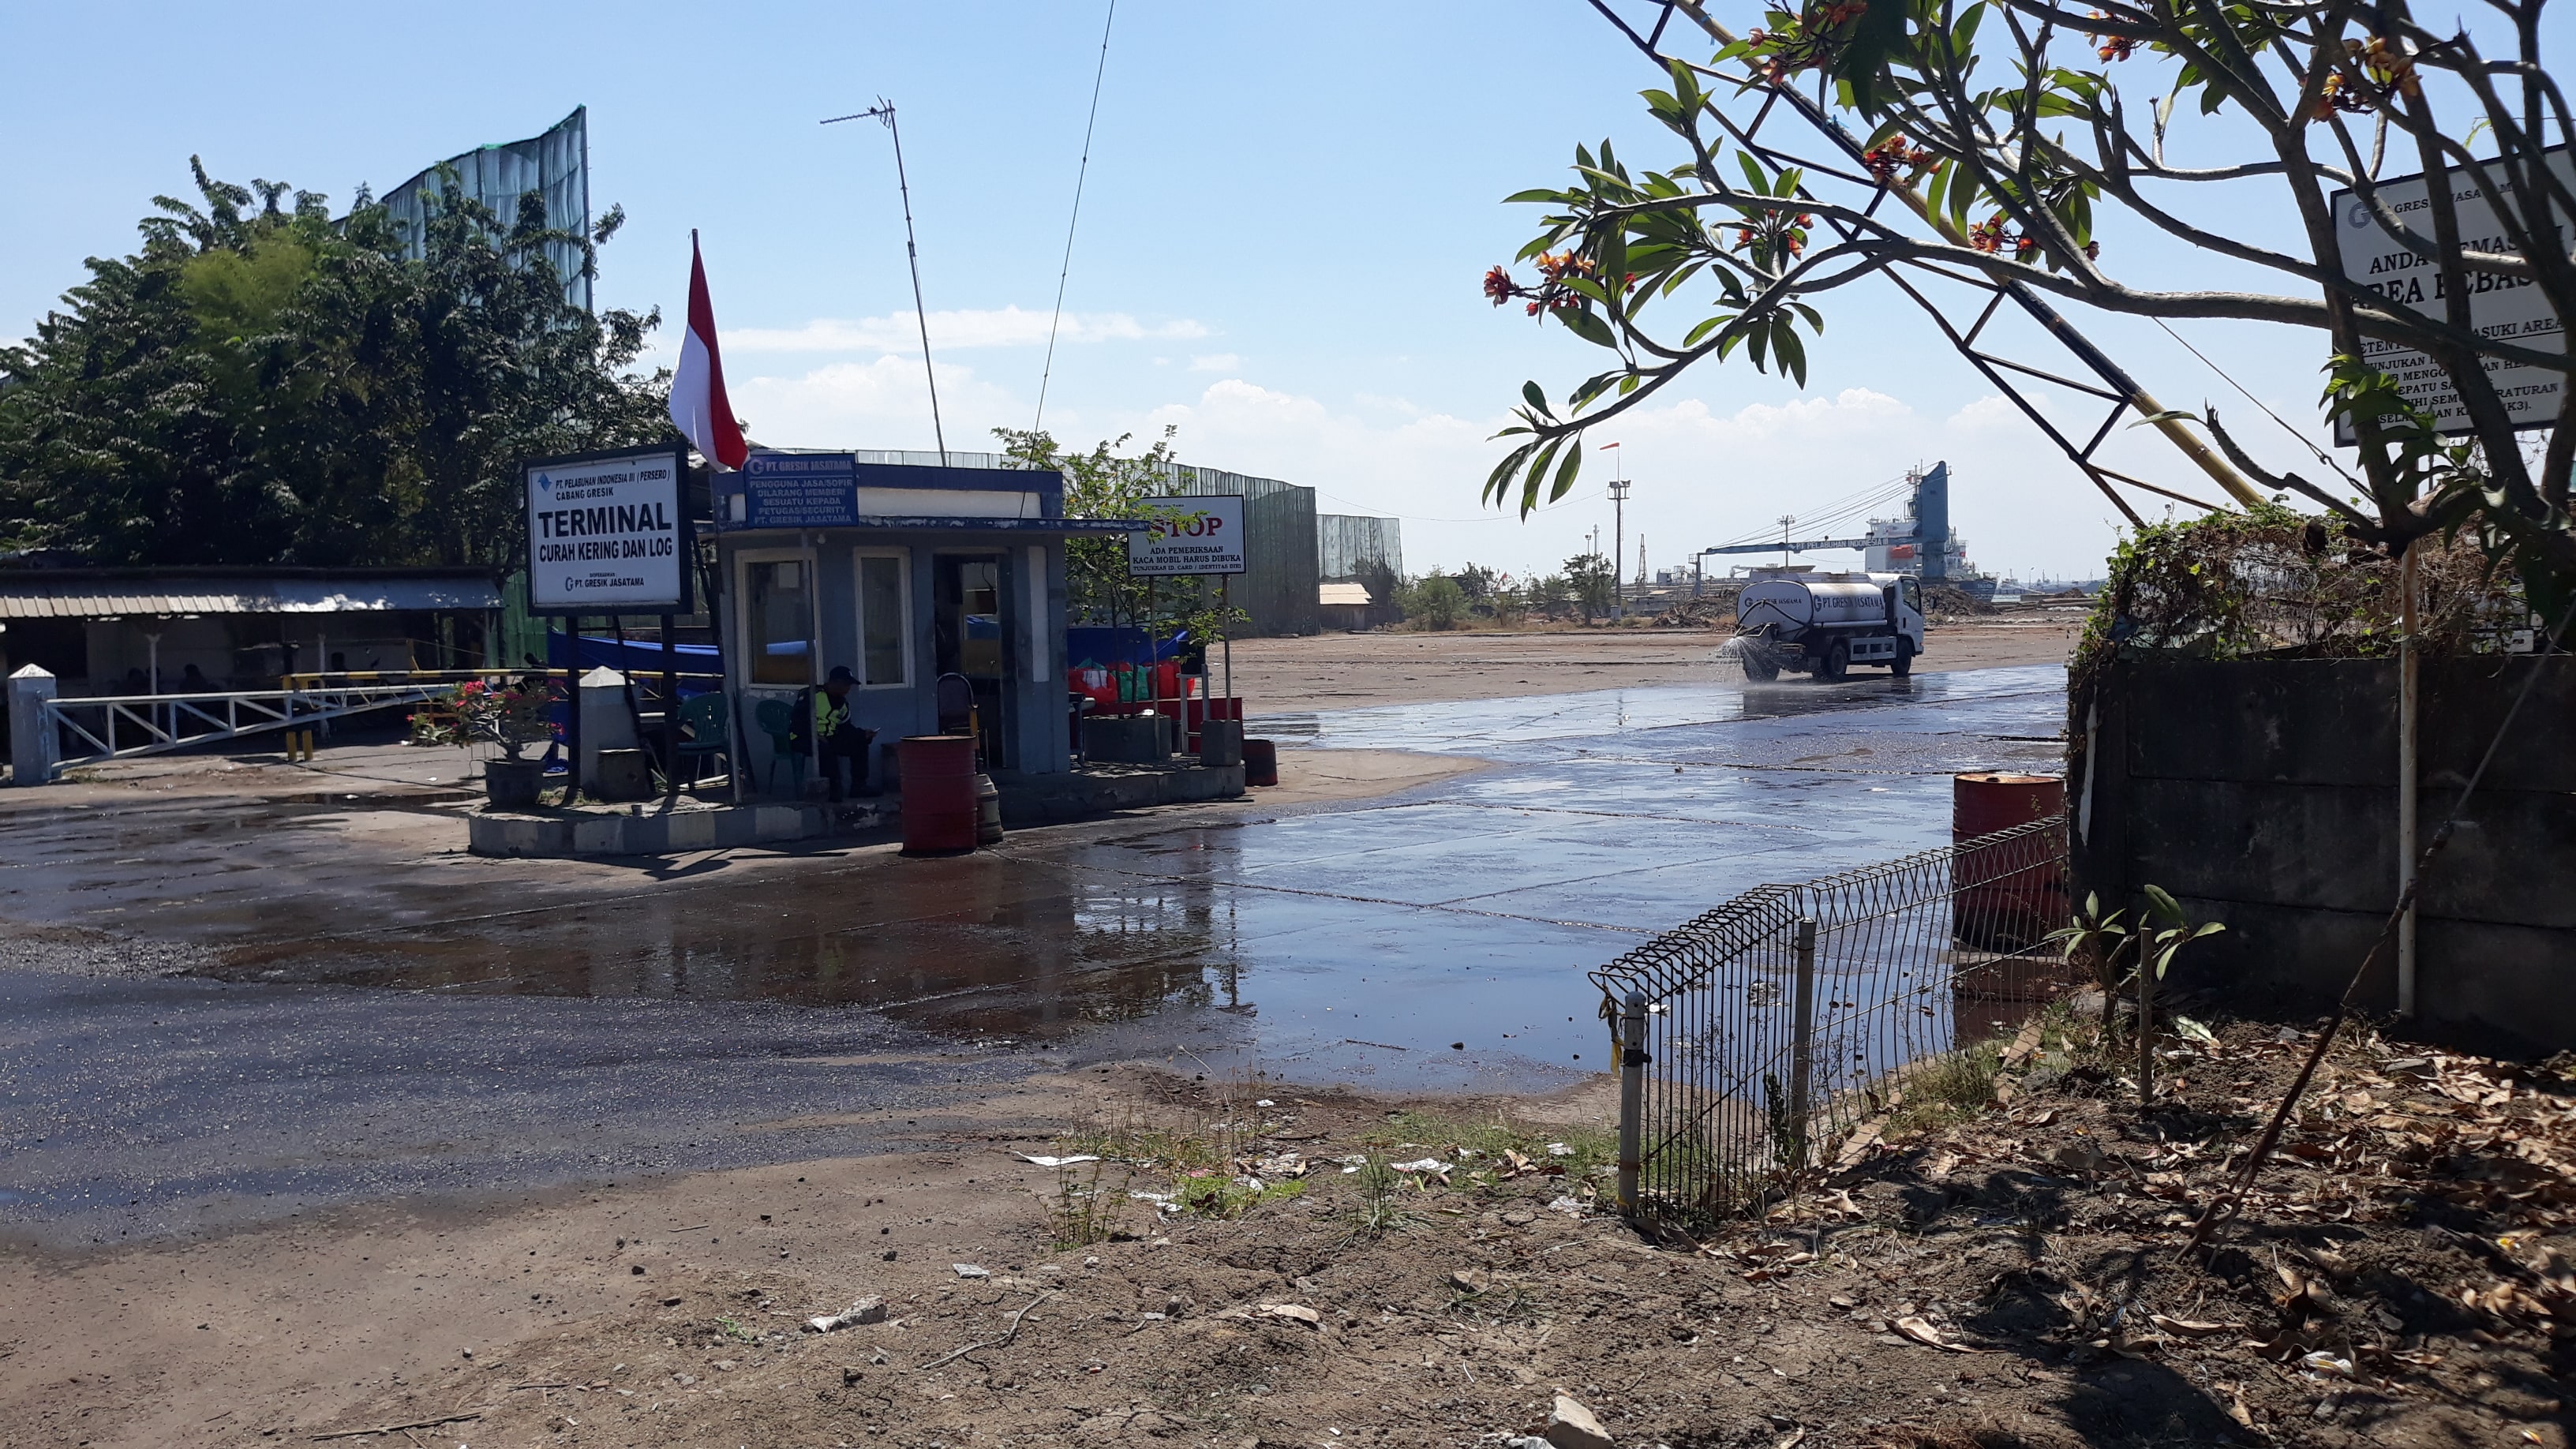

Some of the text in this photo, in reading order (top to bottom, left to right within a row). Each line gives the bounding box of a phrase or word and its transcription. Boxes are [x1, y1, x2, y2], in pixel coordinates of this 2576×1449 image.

[766, 461, 778, 472] PT.
[779, 460, 810, 472] GRESIK
[811, 460, 852, 471] JASATAMA
[556, 479, 564, 489] PT.
[565, 476, 597, 489] PELABUHAN
[597, 474, 627, 485] INDONESIA
[751, 480, 799, 489] PENGGUNA
[556, 487, 614, 501] CABANG GRESIK
[758, 488, 846, 498] DILARANG MEMBERI
[763, 496, 841, 506] SESUATU KEPADA
[537, 502, 672, 538] TERMINAL
[754, 515, 852, 525] PT. GRESIK JASATAMA
[540, 537, 672, 563] CURAH KERING DAN LOG
[1168, 545, 1223, 555] PEMERIKSAAN
[1807, 541, 1847, 549] PELABUHAN
[1133, 556, 1155, 564] KACA
[1156, 555, 1181, 564] MOBIL
[575, 578, 584, 588] PT.
[585, 578, 608, 588] GRESIK
[609, 577, 644, 586] JASATAMA
